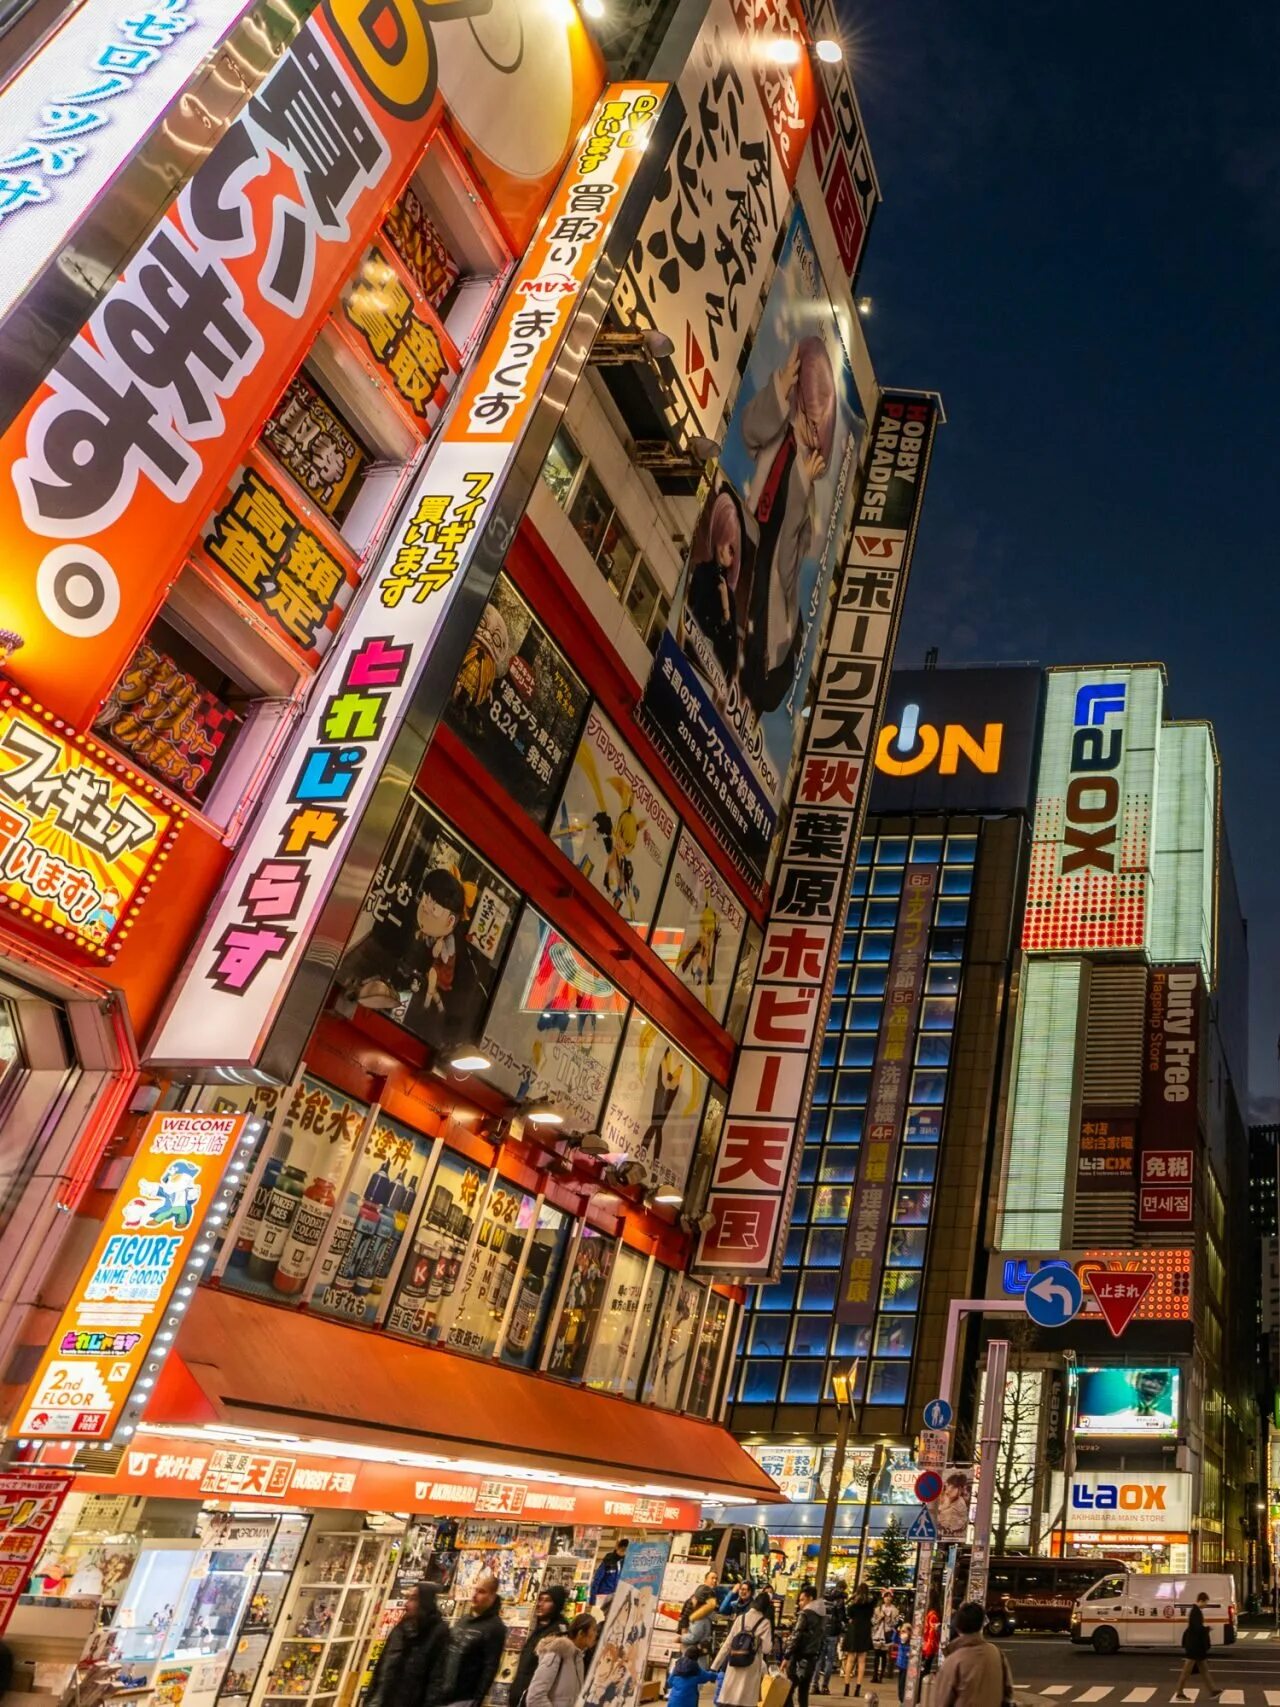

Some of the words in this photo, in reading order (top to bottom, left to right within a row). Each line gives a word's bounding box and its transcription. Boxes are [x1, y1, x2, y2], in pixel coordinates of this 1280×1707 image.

[0, 0, 190, 208] ゼロノツバサ
[617, 94, 657, 149] DVD
[579, 101, 631, 174] 買います
[549, 183, 617, 267] 買取り
[859, 402, 904, 523] PARADISE
[895, 402, 928, 483] HOBBY
[379, 494, 455, 608] 買います
[412, 471, 494, 603] フィギュア
[487, 697, 518, 743] 8.24
[525, 742, 554, 786] 発売!
[660, 656, 772, 842] 全国のボークスで予約受付!!
[1, 720, 157, 863] フィギュア
[205, 635, 414, 997] とれじゃらす
[909, 874, 932, 887] 6F
[892, 991, 914, 1003] 5F
[1150, 973, 1166, 1029] Flagship
[1163, 972, 1198, 1036] Duty
[1150, 1032, 1165, 1072] Store
[1163, 1040, 1196, 1103] Free
[163, 1118, 234, 1132] WELCOME
[871, 1126, 893, 1141] 4F
[1145, 1156, 1189, 1178] 免税
[298, 1210, 327, 1232] MODEL
[1142, 1195, 1189, 1214] 면세점
[101, 1236, 184, 1268] FIGURE
[294, 1223, 323, 1241] COLOR
[93, 1268, 128, 1285] ANIME
[129, 1268, 169, 1285] GOODS
[1099, 1283, 1141, 1300] 止まれ
[40, 1391, 95, 1407] FLOOR
[49, 1368, 82, 1392] 2nd
[1071, 1514, 1117, 1522] AKIHABARA
[1118, 1514, 1139, 1522] MAIN
[1139, 1514, 1166, 1522] STORE
